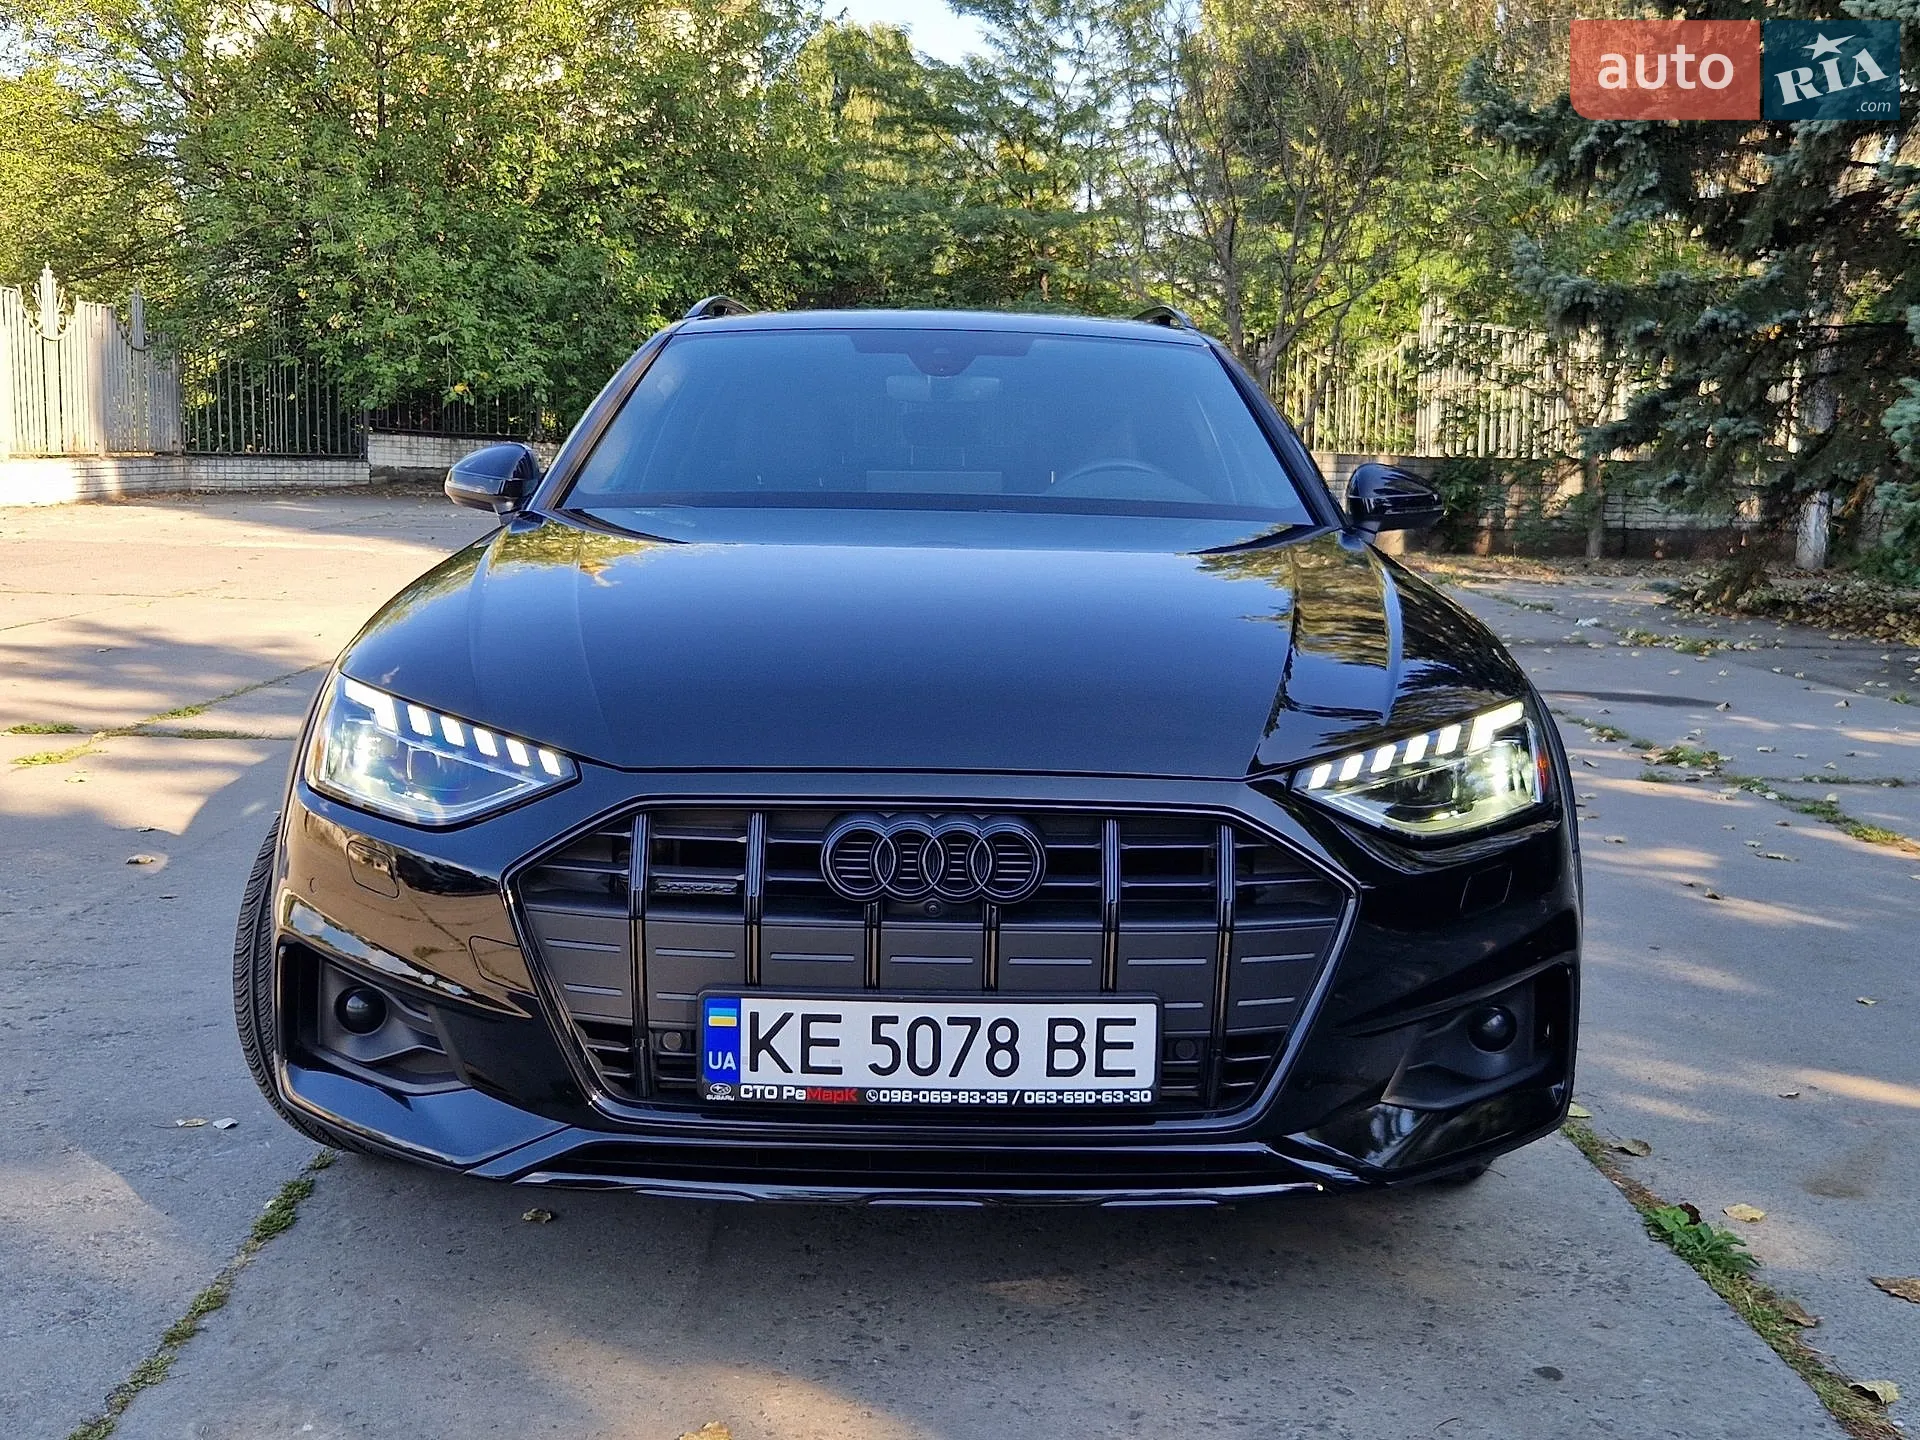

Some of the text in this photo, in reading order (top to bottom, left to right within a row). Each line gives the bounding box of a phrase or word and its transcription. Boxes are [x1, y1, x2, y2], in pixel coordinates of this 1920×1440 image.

[708, 1051, 737, 1071] UA
[749, 1012, 1137, 1078] KE 5078 BE
